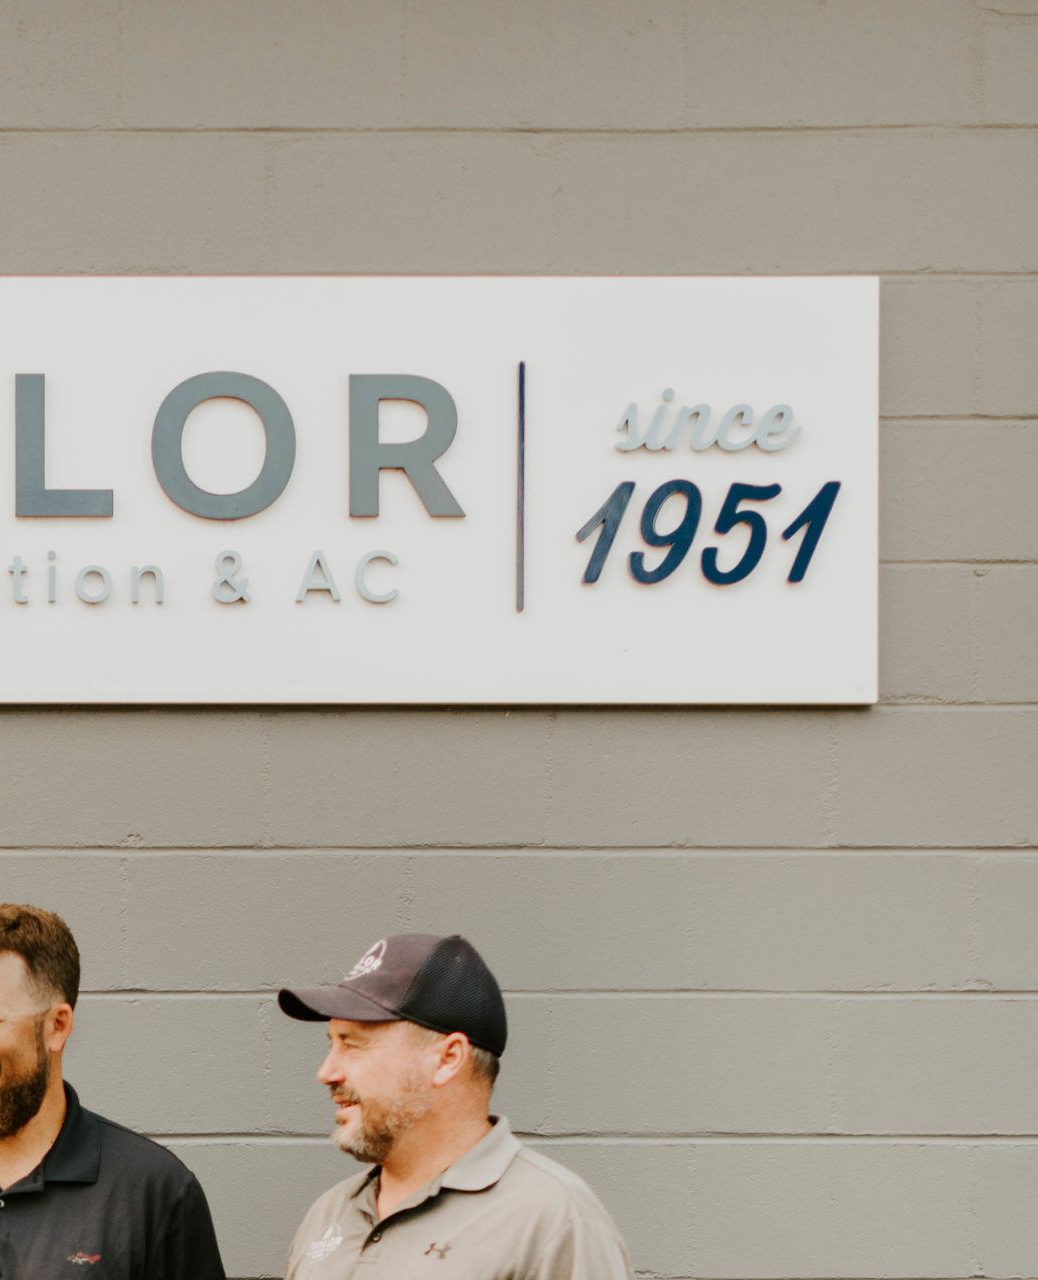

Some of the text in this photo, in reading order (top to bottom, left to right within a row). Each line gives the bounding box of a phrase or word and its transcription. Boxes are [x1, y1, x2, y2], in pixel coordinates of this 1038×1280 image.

[614, 388, 802, 456] since
[576, 478, 843, 587] 1951
[211, 550, 252, 608] &
[294, 550, 402, 607] AC
